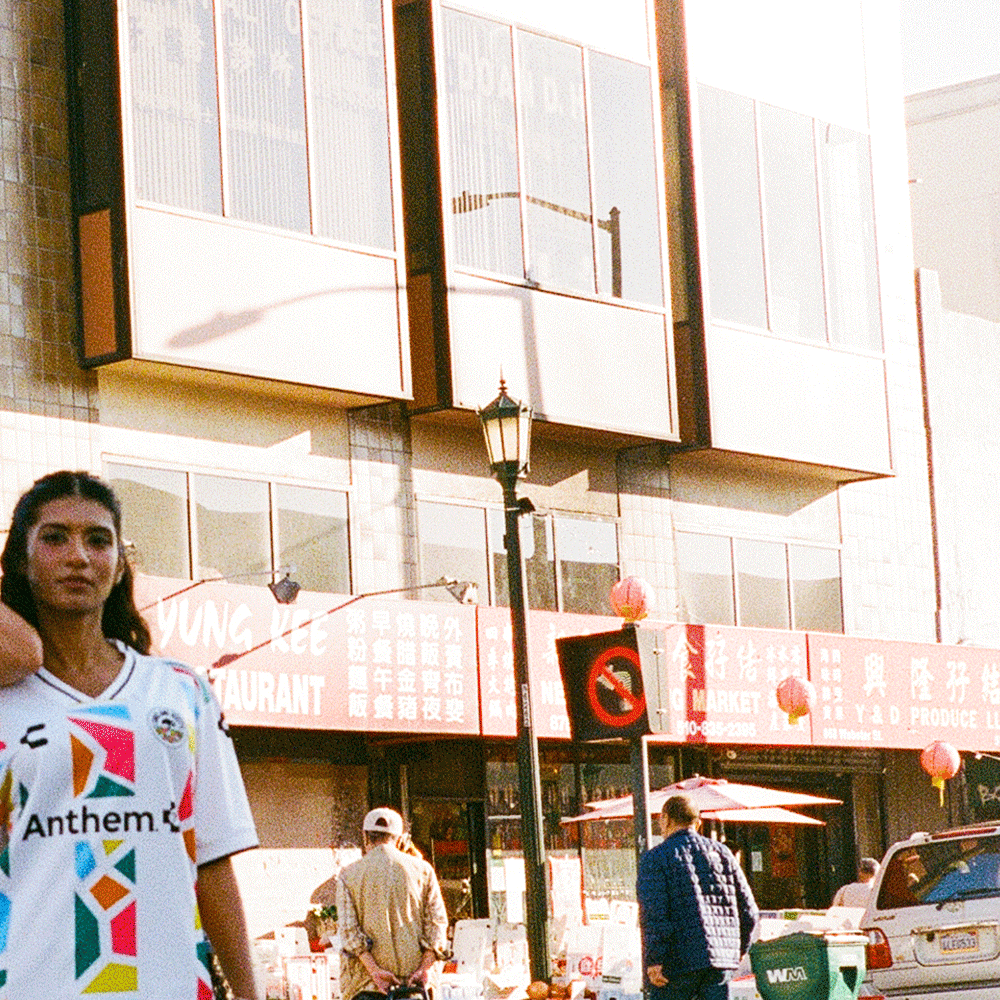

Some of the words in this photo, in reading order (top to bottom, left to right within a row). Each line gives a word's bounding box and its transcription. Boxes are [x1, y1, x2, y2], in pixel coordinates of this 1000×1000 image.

[157, 596, 252, 650] YUNG
[270, 606, 329, 656] KEE
[541, 680, 566, 705] NE
[692, 688, 762, 715] MARKET
[855, 704, 866, 724] Y
[872, 705, 884, 725] &
[889, 705, 900, 725] D
[910, 706, 978, 729] PRODUCE
[986, 711, 1000, 730] LL
[766, 966, 808, 984] WM
